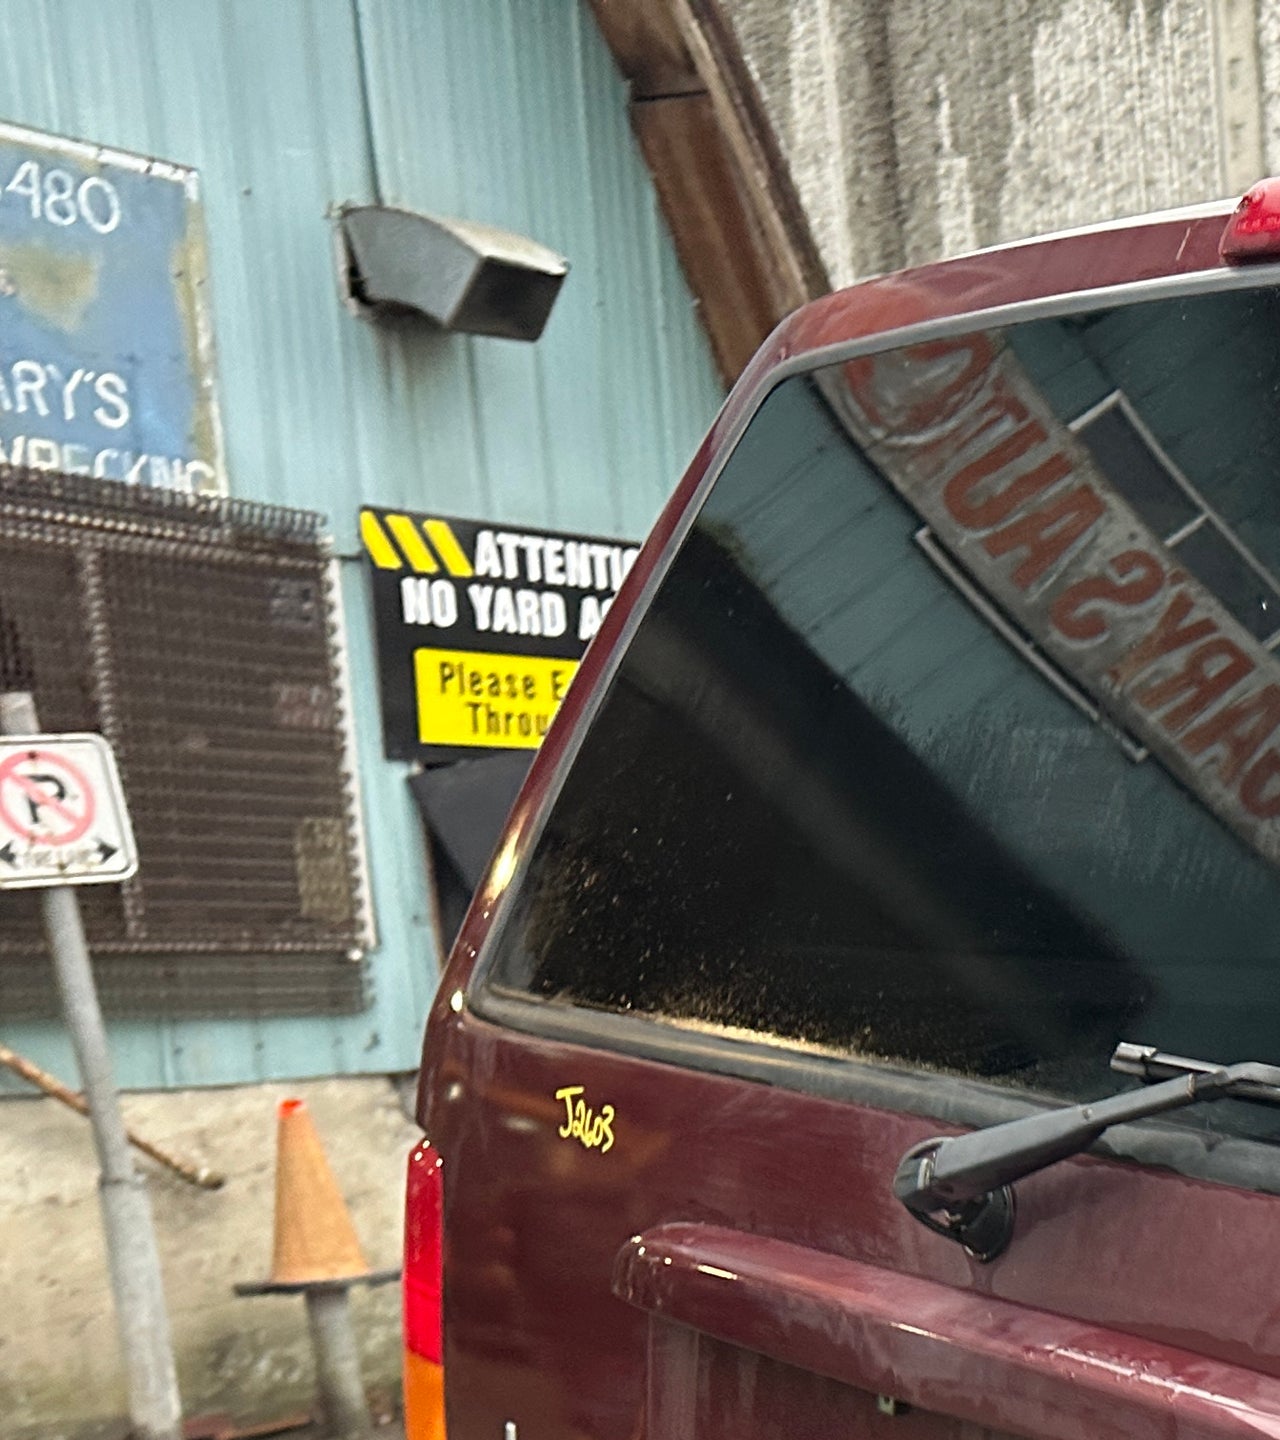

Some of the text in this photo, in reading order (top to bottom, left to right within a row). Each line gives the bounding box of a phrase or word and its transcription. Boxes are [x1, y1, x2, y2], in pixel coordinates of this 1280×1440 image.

[401, 576, 458, 628] NO
[467, 584, 567, 638] YARD
[440, 661, 538, 700] Please
